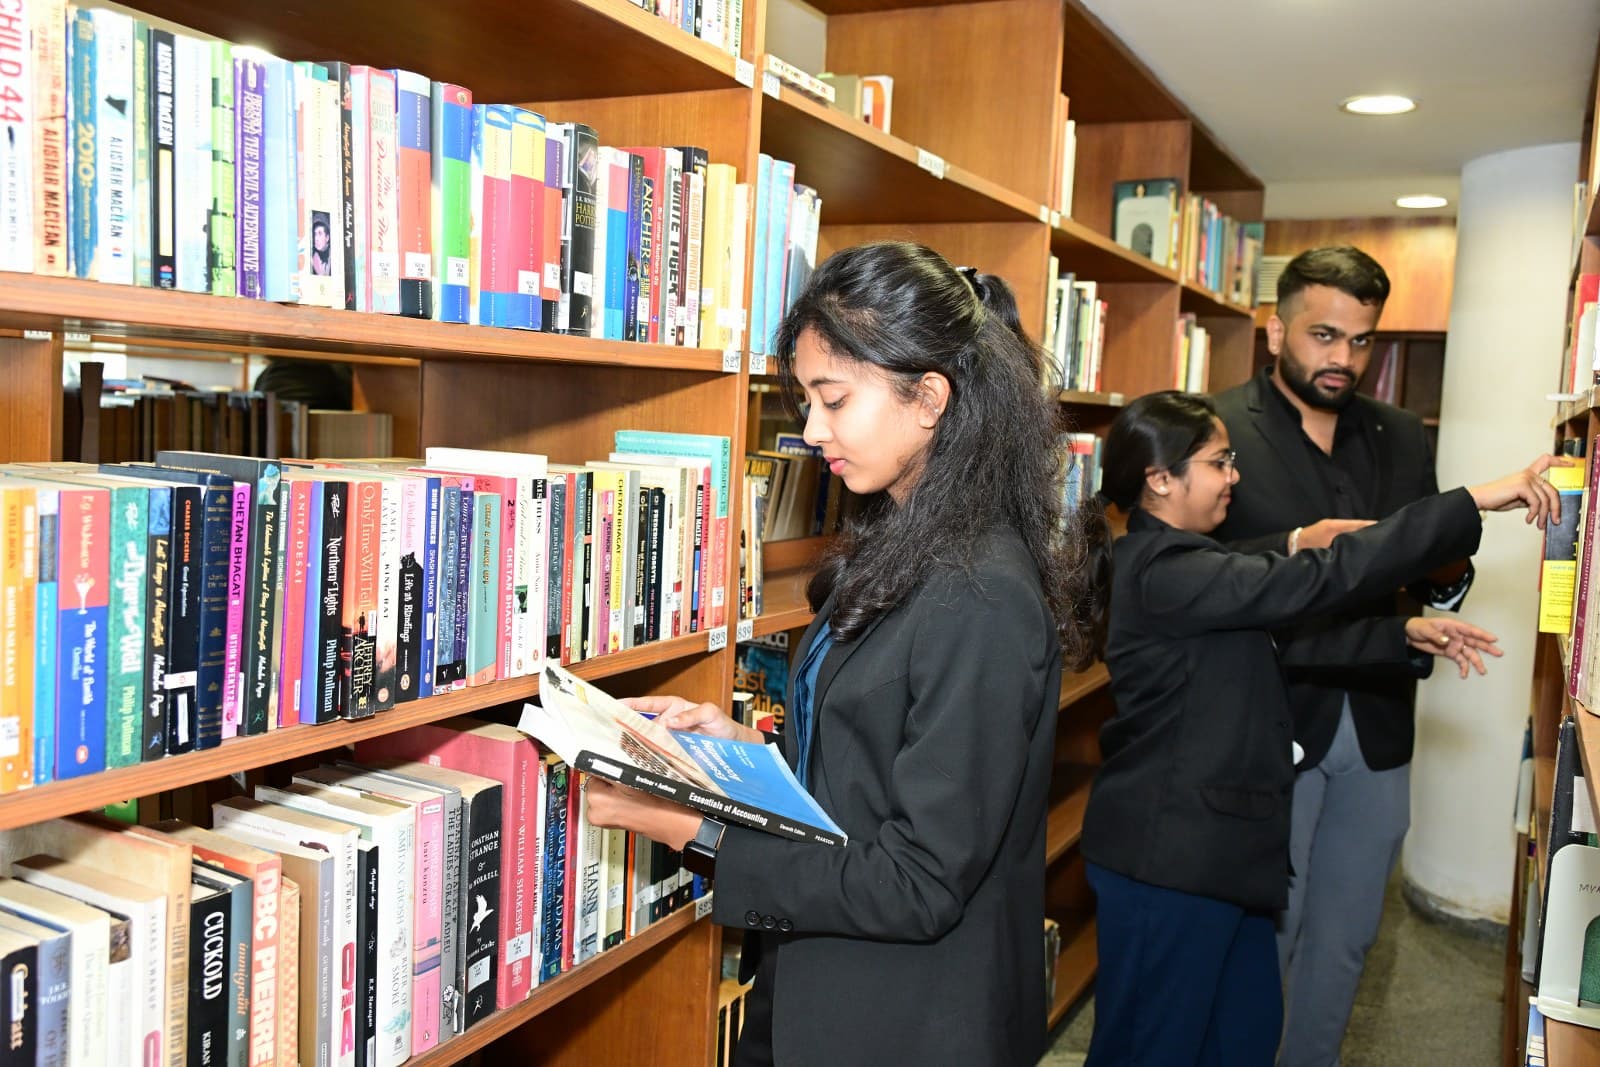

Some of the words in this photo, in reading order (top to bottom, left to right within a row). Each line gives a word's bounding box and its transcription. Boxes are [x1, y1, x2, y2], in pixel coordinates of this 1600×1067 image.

[0, 0, 23, 77] CHILD
[158, 42, 172, 94] ALISTAIR
[0, 86, 24, 124] 44
[43, 128, 59, 186] ALISTAIR
[77, 121, 95, 188] 2010:
[109, 136, 124, 185] ALISTAIR
[244, 137, 260, 157] THE
[376, 137, 386, 210] Peacock
[44, 190, 60, 247] MACLEAN
[110, 189, 124, 238] MACLEAN
[640, 183, 654, 259] ARCHER
[670, 181, 682, 232] WHITE
[243, 203, 260, 271] ALTERNATIVE
[669, 242, 680, 294] TIGER
[720, 439, 728, 456] SIX
[360, 485, 376, 517] Only
[431, 488, 439, 510] SHOW
[507, 499, 515, 507] 2
[553, 488, 562, 516] LOUIS
[696, 489, 704, 517] ALISTAIR
[719, 460, 727, 512] SUSPECTS
[184, 500, 192, 530] CHARLES
[234, 492, 247, 543] CHETAN
[296, 493, 306, 535] ANITA
[380, 488, 389, 557] CLAVELL'S
[389, 502, 397, 543] JAMES
[449, 491, 458, 518] LOUIS
[461, 497, 471, 523] LOUIS
[534, 479, 545, 534] MISTRESS
[362, 521, 374, 552] Time
[429, 510, 438, 545] BUSINESS
[651, 509, 659, 549] FREDERICK
[717, 521, 725, 555] VIKAS
[1587, 511, 1596, 537] Cost
[155, 539, 168, 559] Last
[182, 532, 191, 563] DICKENS
[294, 541, 304, 584] DESAI
[325, 536, 342, 582] Northern
[428, 549, 436, 574] SHASHI
[153, 561, 167, 584] Tango
[182, 566, 190, 581] Great
[231, 547, 243, 597] BHAGAT
[361, 556, 373, 582] Will
[382, 563, 391, 592] KING
[403, 573, 414, 590] Life
[505, 547, 514, 592] CHETAN
[1581, 540, 1594, 601] Accounting
[180, 583, 189, 618] Expectations
[324, 584, 340, 616] Lights
[360, 584, 372, 608] Tell
[382, 598, 390, 620] RAT
[403, 591, 413, 602] at
[427, 575, 435, 608] THAROOR
[400, 604, 413, 643] Blandings
[504, 594, 513, 638] BHAGAT
[737, 626, 752, 640] 839
[121, 630, 143, 674] Well
[323, 639, 338, 668] Philip
[710, 631, 726, 647] 823
[151, 654, 166, 690] Malcolm
[353, 636, 366, 694] ARCHER
[361, 643, 375, 685] JEFFREY
[734, 667, 766, 692] ast
[122, 686, 135, 713] Philip
[323, 671, 336, 712] Pullman
[121, 715, 135, 755] Pullman
[447, 809, 456, 831] THE
[688, 792, 723, 810] Essentials
[723, 804, 733, 814] of
[731, 807, 769, 827] Accounting
[422, 841, 431, 863] hari
[446, 834, 455, 871] LADIES
[471, 830, 500, 849] ONATHAN
[516, 824, 526, 875] WILLIAM
[556, 807, 568, 888] DOUGLAS
[814, 835, 835, 846] PEARSON
[254, 867, 279, 941] DBC
[344, 881, 353, 926] SWARUP
[395, 878, 406, 925] GHOSH
[421, 867, 430, 905] kunzru
[444, 883, 453, 919] GRACE
[321, 919, 330, 947] Family
[443, 921, 451, 955] ADIEU
[554, 895, 565, 951] ADAMS
[203, 911, 225, 1000] CUCKOLD
[400, 957, 409, 990] RIVER
[232, 942, 249, 1016] immigrant
[391, 966, 401, 1007] SMOKE
[251, 945, 277, 1066] PIERRE
[366, 995, 375, 1028] Narayan
[400, 996, 407, 1007] OF
[201, 1031, 212, 1064] KIRAN
